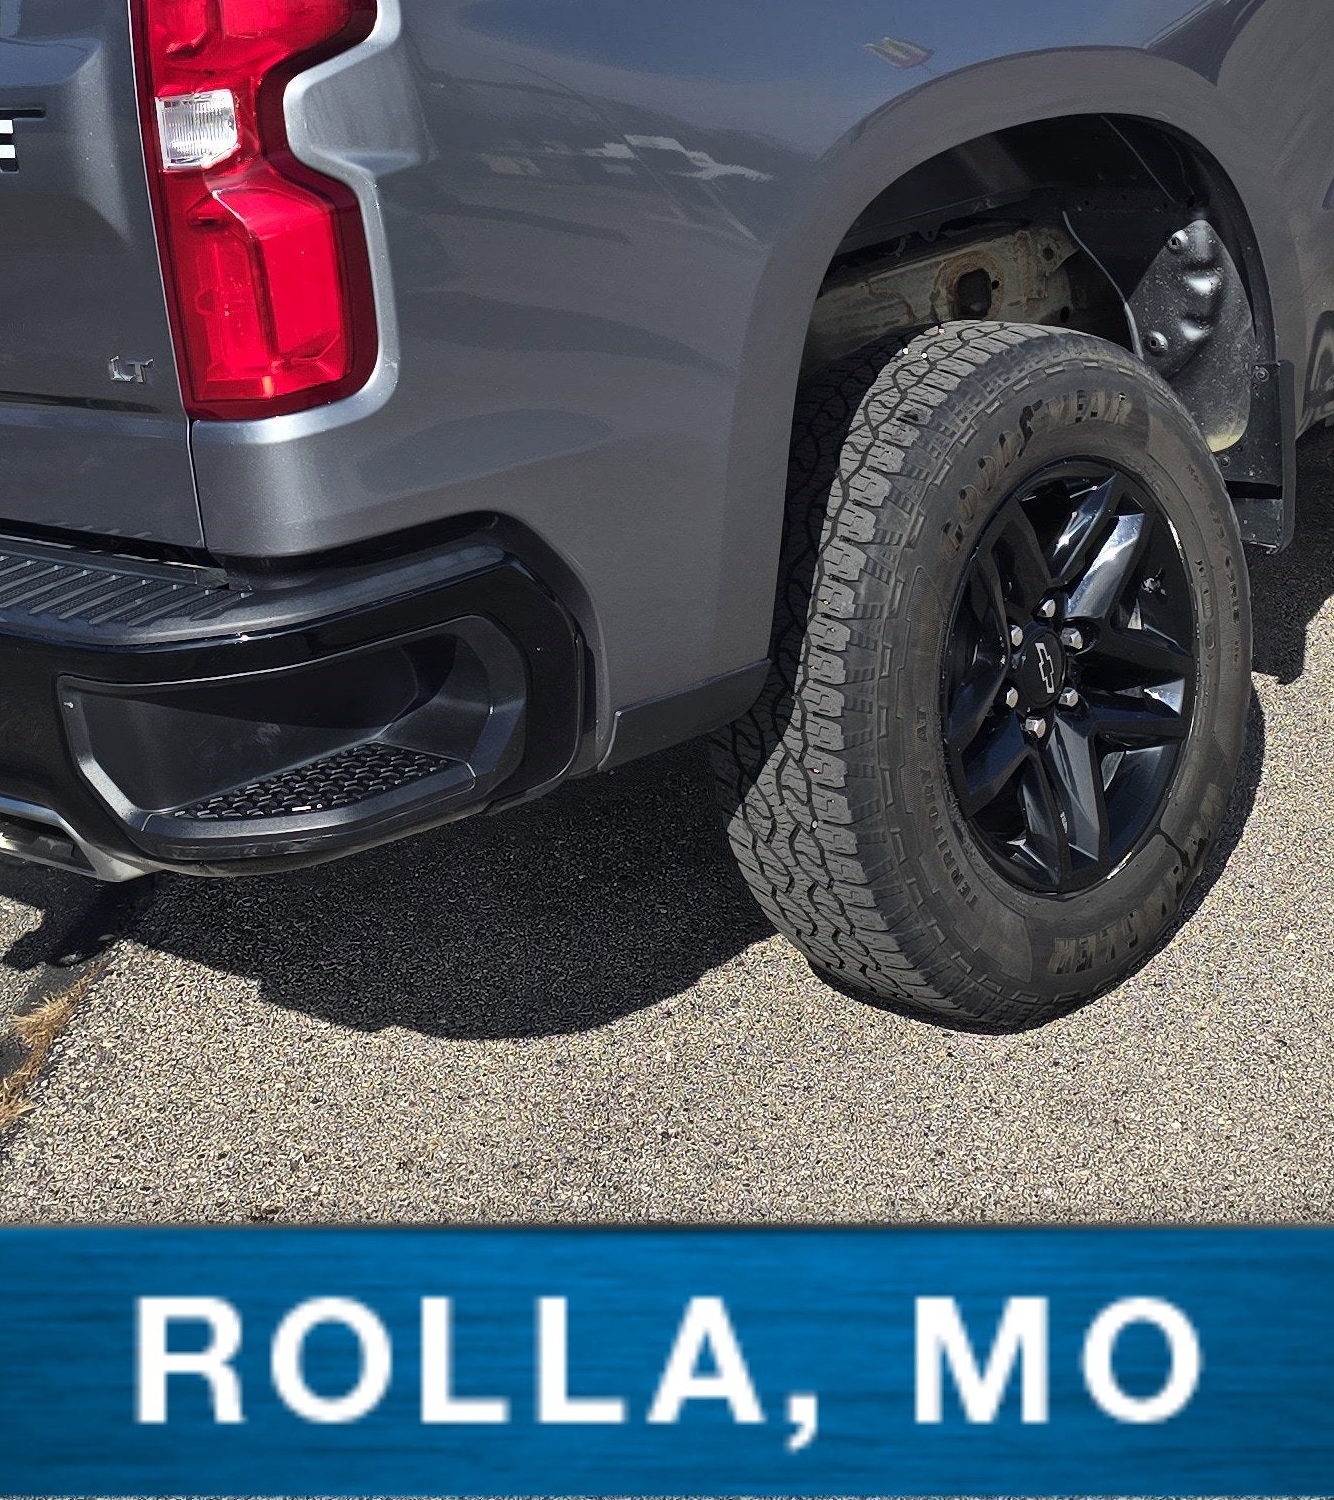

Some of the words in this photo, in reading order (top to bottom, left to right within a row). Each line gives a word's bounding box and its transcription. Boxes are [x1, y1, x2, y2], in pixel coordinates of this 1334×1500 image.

[109, 355, 155, 384] LT
[939, 388, 1134, 562] GOODYEAR
[919, 766, 979, 913] TERRITORY
